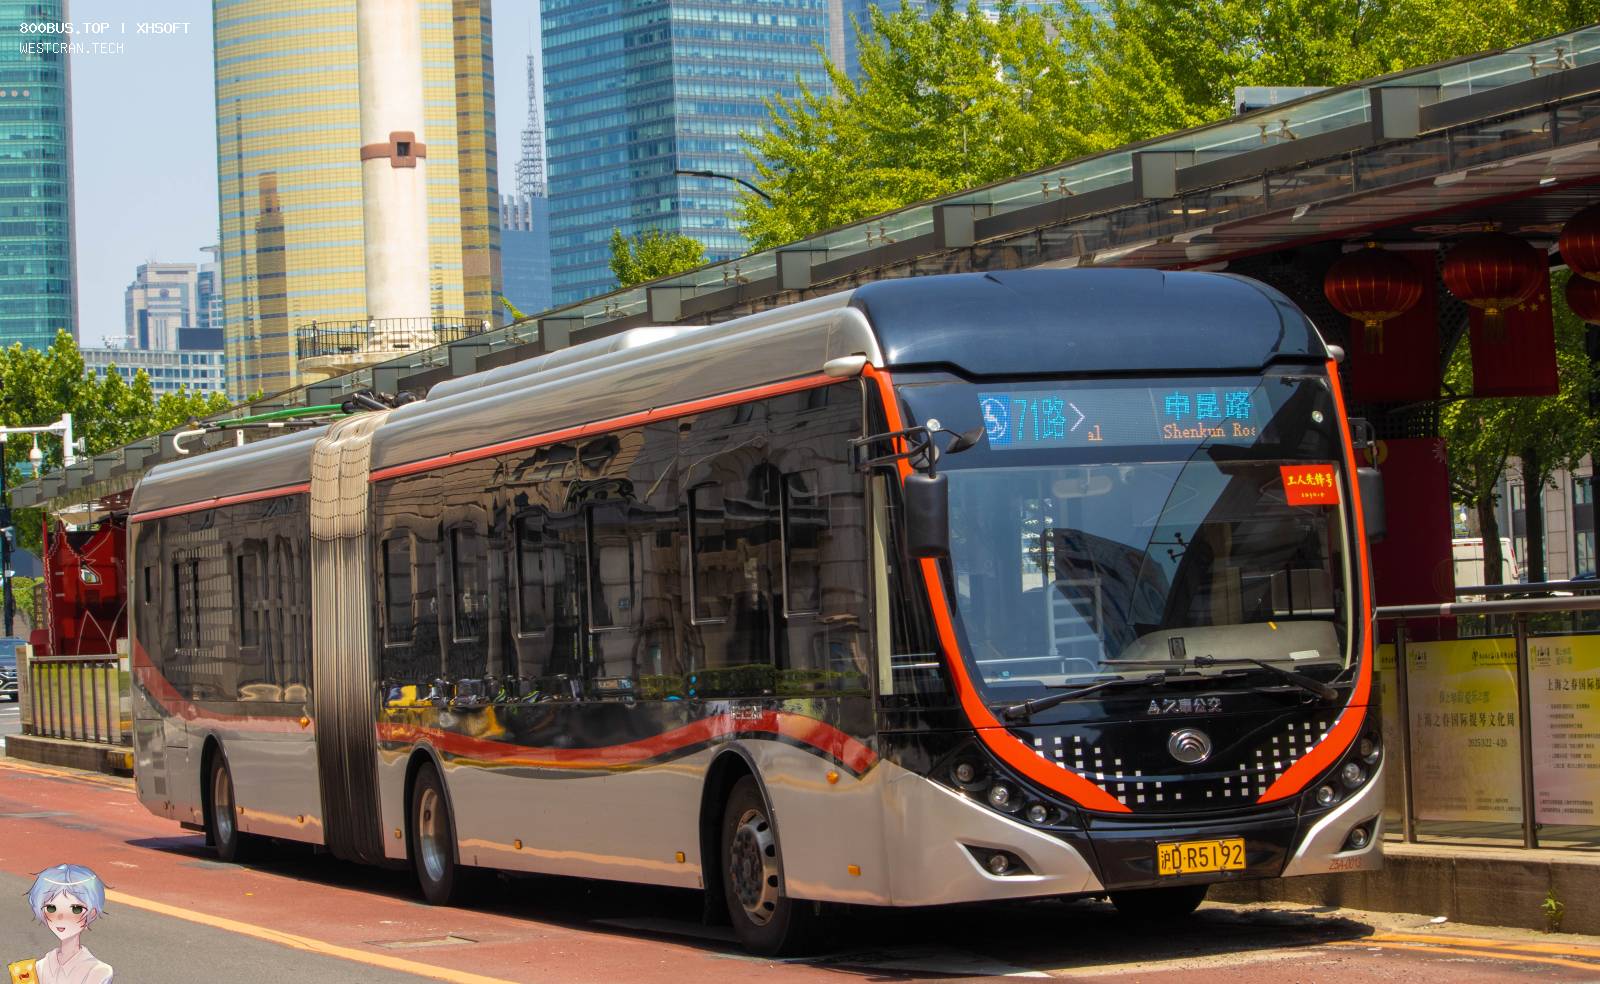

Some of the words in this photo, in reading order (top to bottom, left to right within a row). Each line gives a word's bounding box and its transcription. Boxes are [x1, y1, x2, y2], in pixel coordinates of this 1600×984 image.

[1164, 391, 1252, 421] 申昆路
[1013, 396, 1066, 441] 71路
[1163, 422, 1226, 439] Shenkun
[1287, 472, 1333, 488] 工人先锋号
